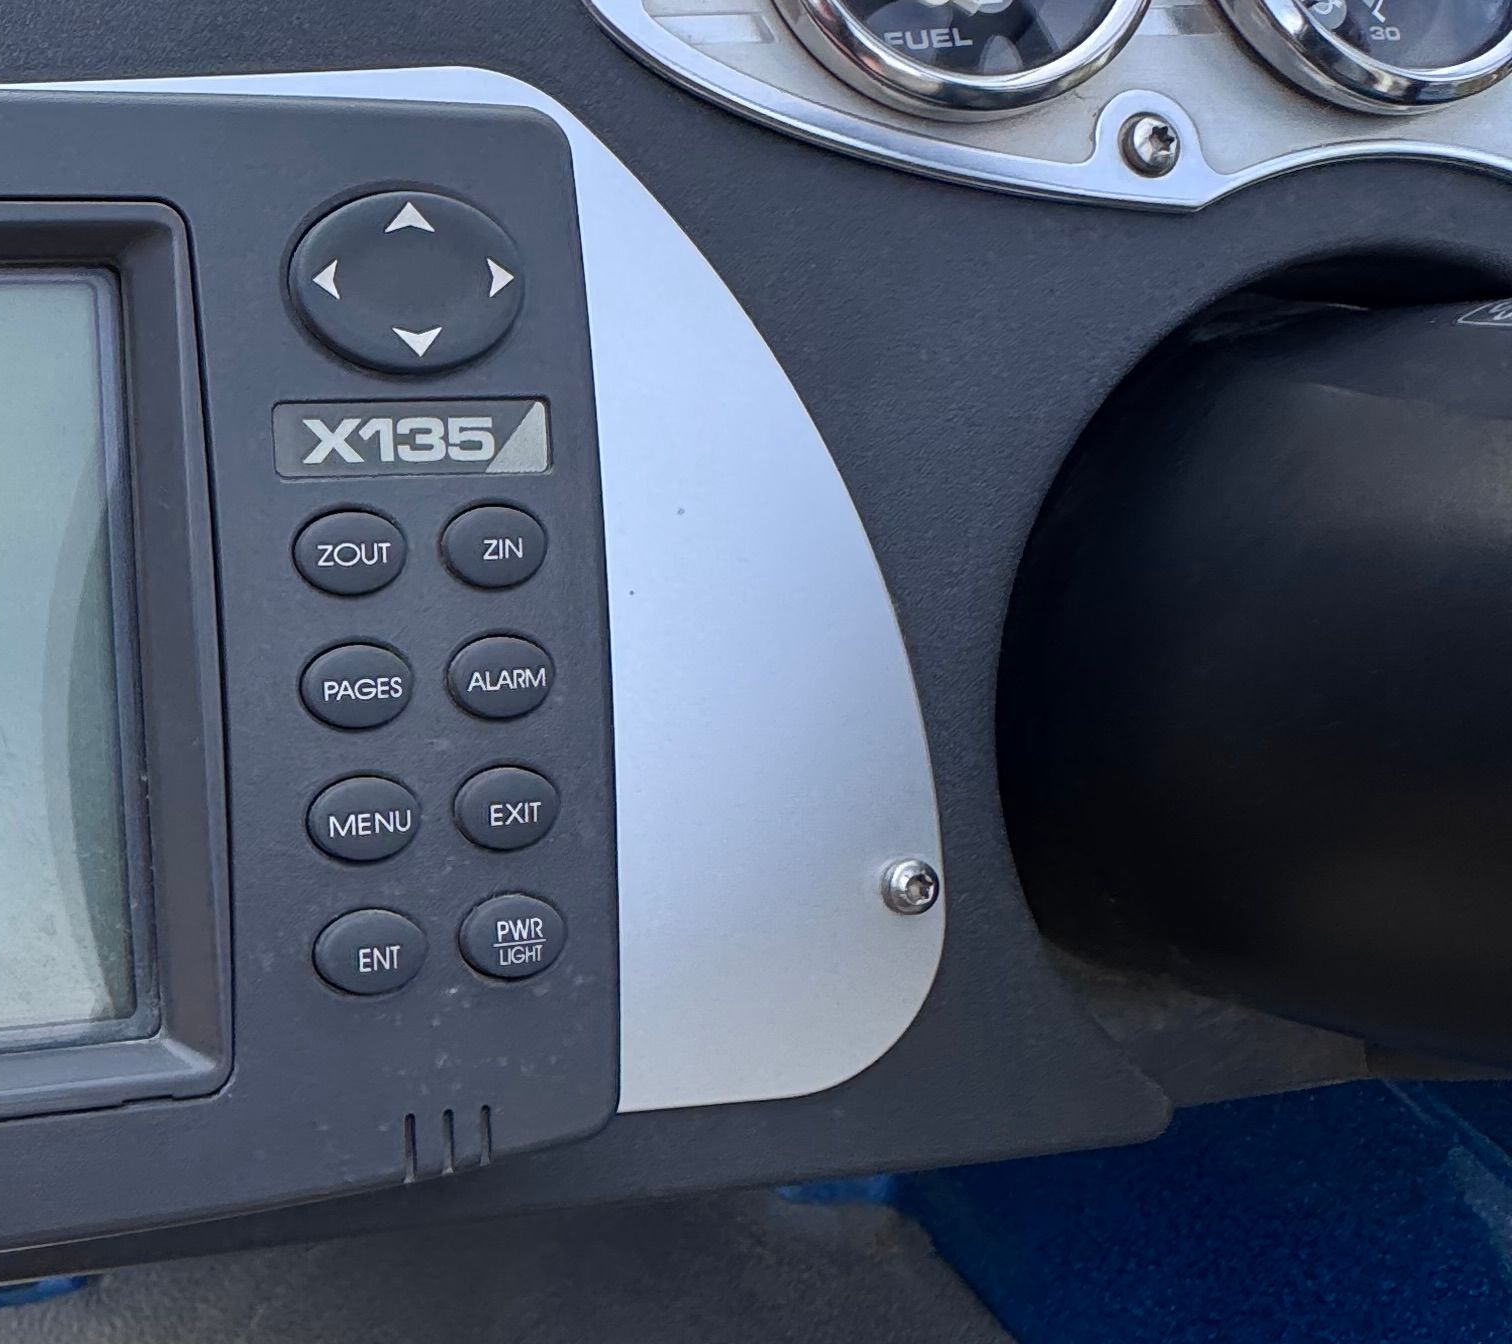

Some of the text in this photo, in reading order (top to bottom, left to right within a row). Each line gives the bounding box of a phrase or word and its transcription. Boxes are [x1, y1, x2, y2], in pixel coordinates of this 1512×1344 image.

[883, 28, 974, 50] FUEL
[1369, 26, 1401, 41] 30
[301, 415, 496, 465] X135
[316, 541, 392, 567] ZOUT
[482, 536, 524, 561] ZIN
[322, 675, 403, 702] PAGES
[466, 667, 547, 692] ALARM
[327, 809, 412, 839] MENU
[489, 800, 543, 827] EXIT
[495, 917, 545, 943] PWR
[358, 945, 401, 973] ENT
[498, 943, 543, 966] LIGHT
